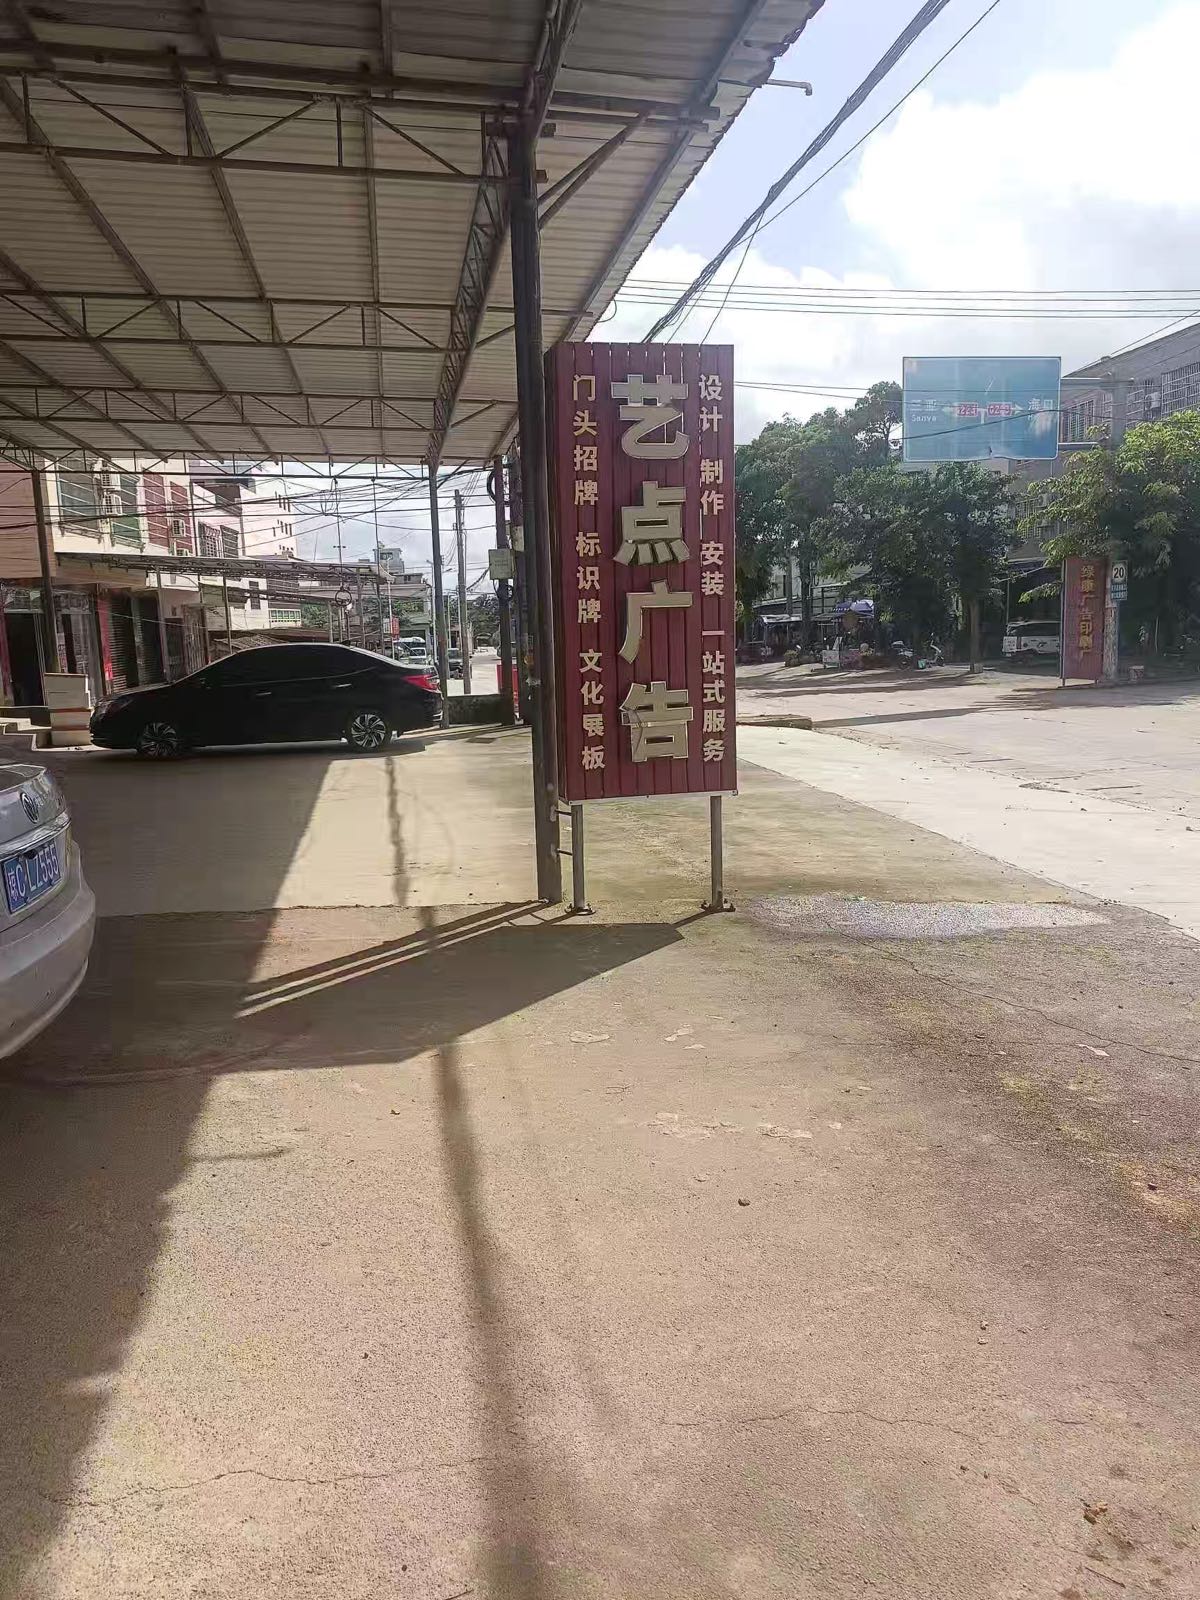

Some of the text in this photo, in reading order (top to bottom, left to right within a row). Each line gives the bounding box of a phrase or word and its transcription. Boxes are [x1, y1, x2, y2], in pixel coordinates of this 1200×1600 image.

[573, 374, 606, 770] 门头招牌 标识牌 文化展板
[611, 374, 693, 762] 艺点广告
[699, 374, 726, 762] 设计 制作 安装 一站式服务
[1113, 567, 1125, 579] 20
